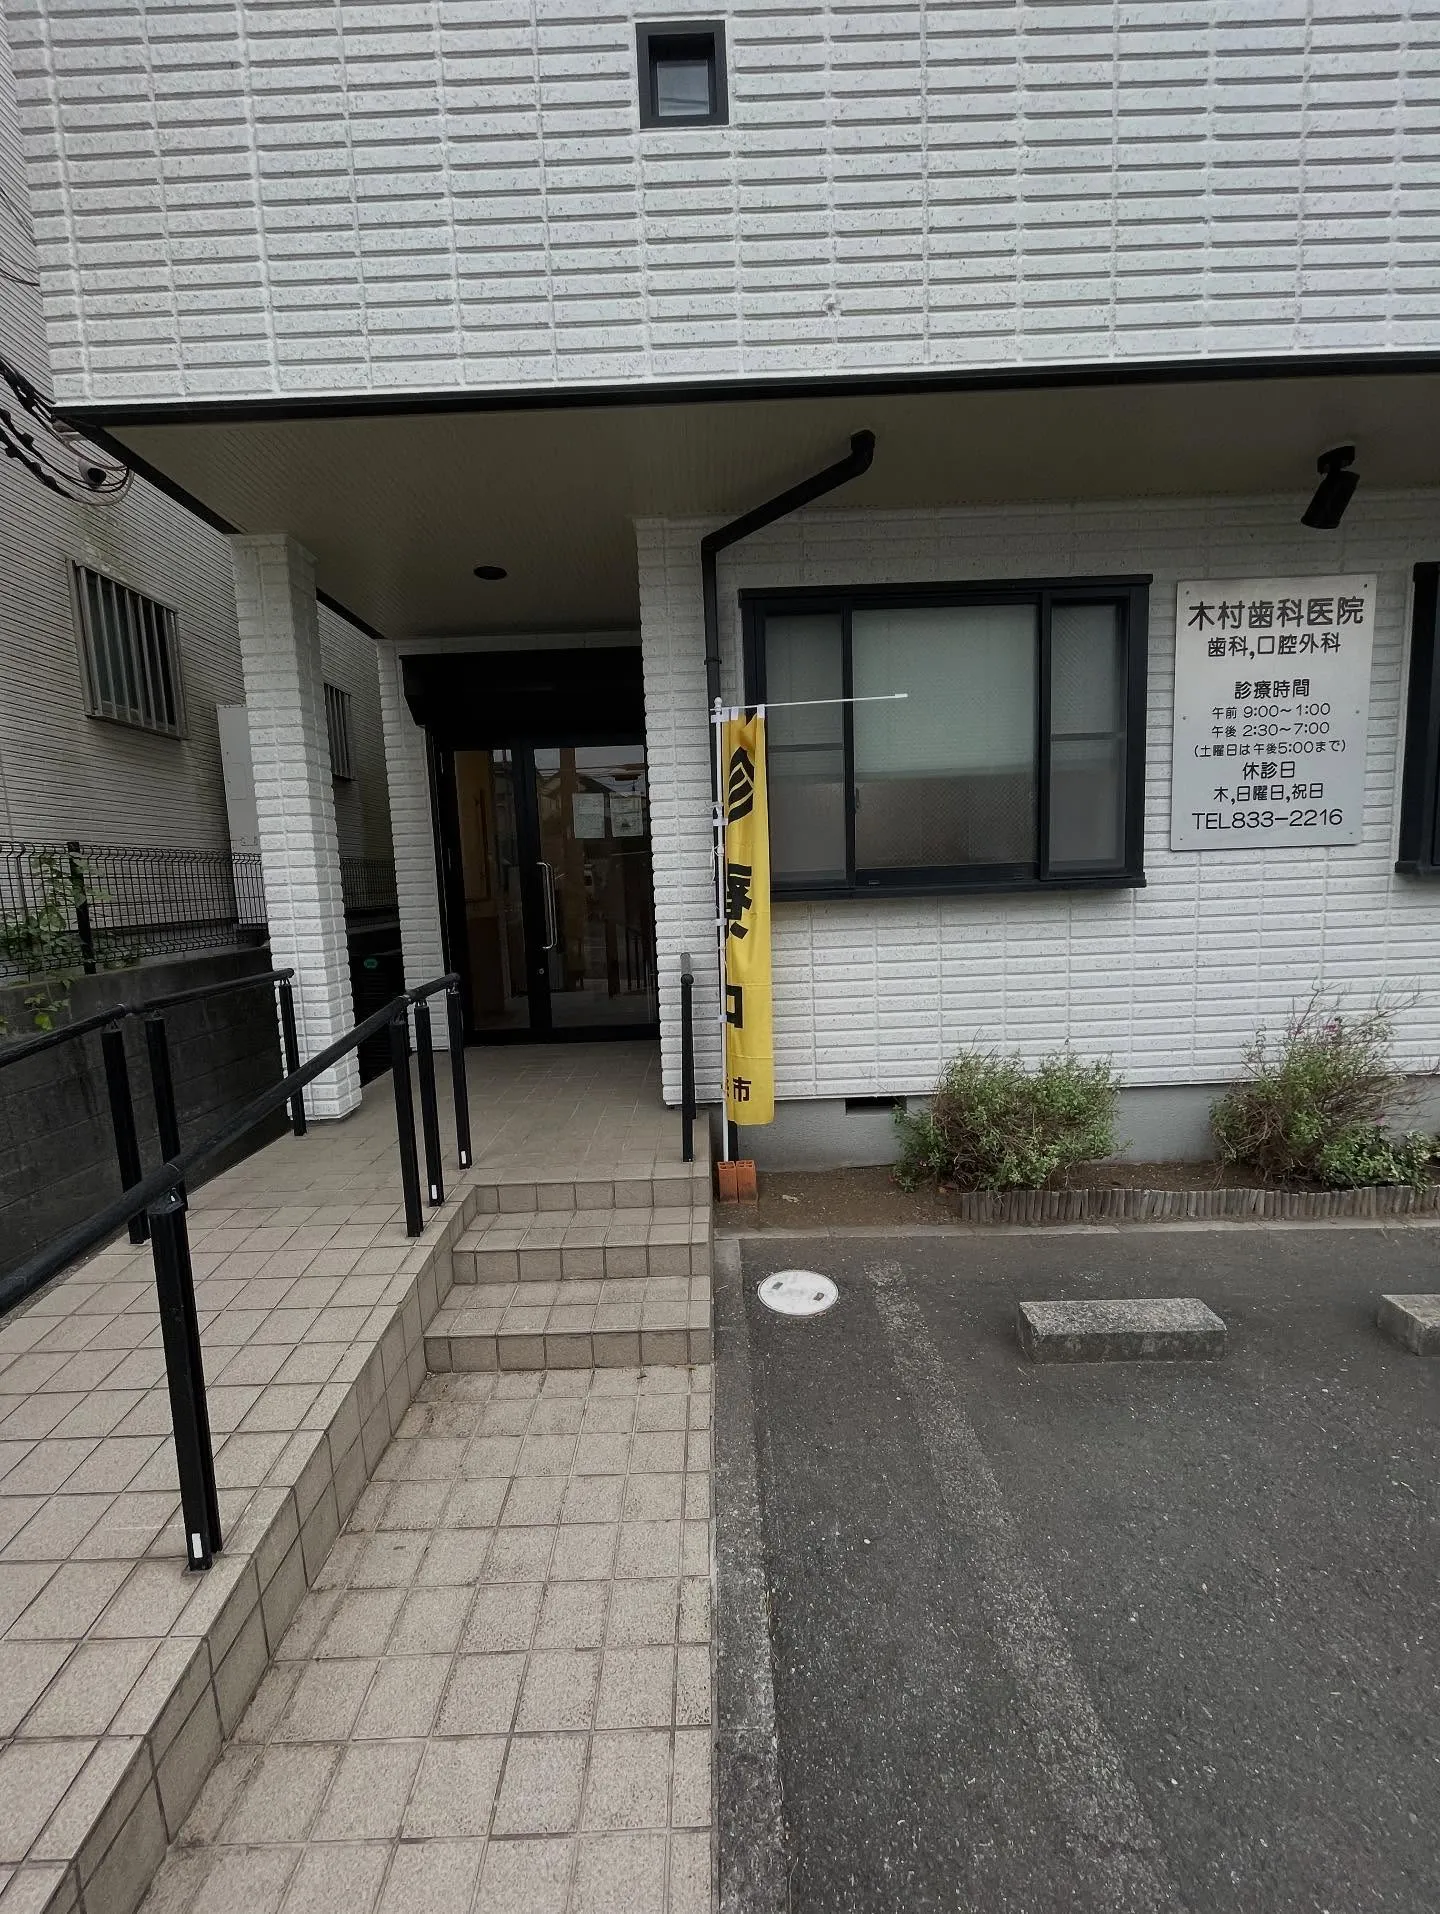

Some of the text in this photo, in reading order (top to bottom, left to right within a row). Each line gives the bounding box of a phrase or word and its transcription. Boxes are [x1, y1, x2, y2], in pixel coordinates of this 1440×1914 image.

[1187, 596, 1365, 631] 木村歯科医院
[1234, 678, 1311, 699] 診療時間
[1211, 706, 1238, 720] 午前
[1211, 725, 1237, 738] 午後
[1242, 760, 1296, 780] 休診日
[1191, 808, 1343, 830] TEL833-2216
